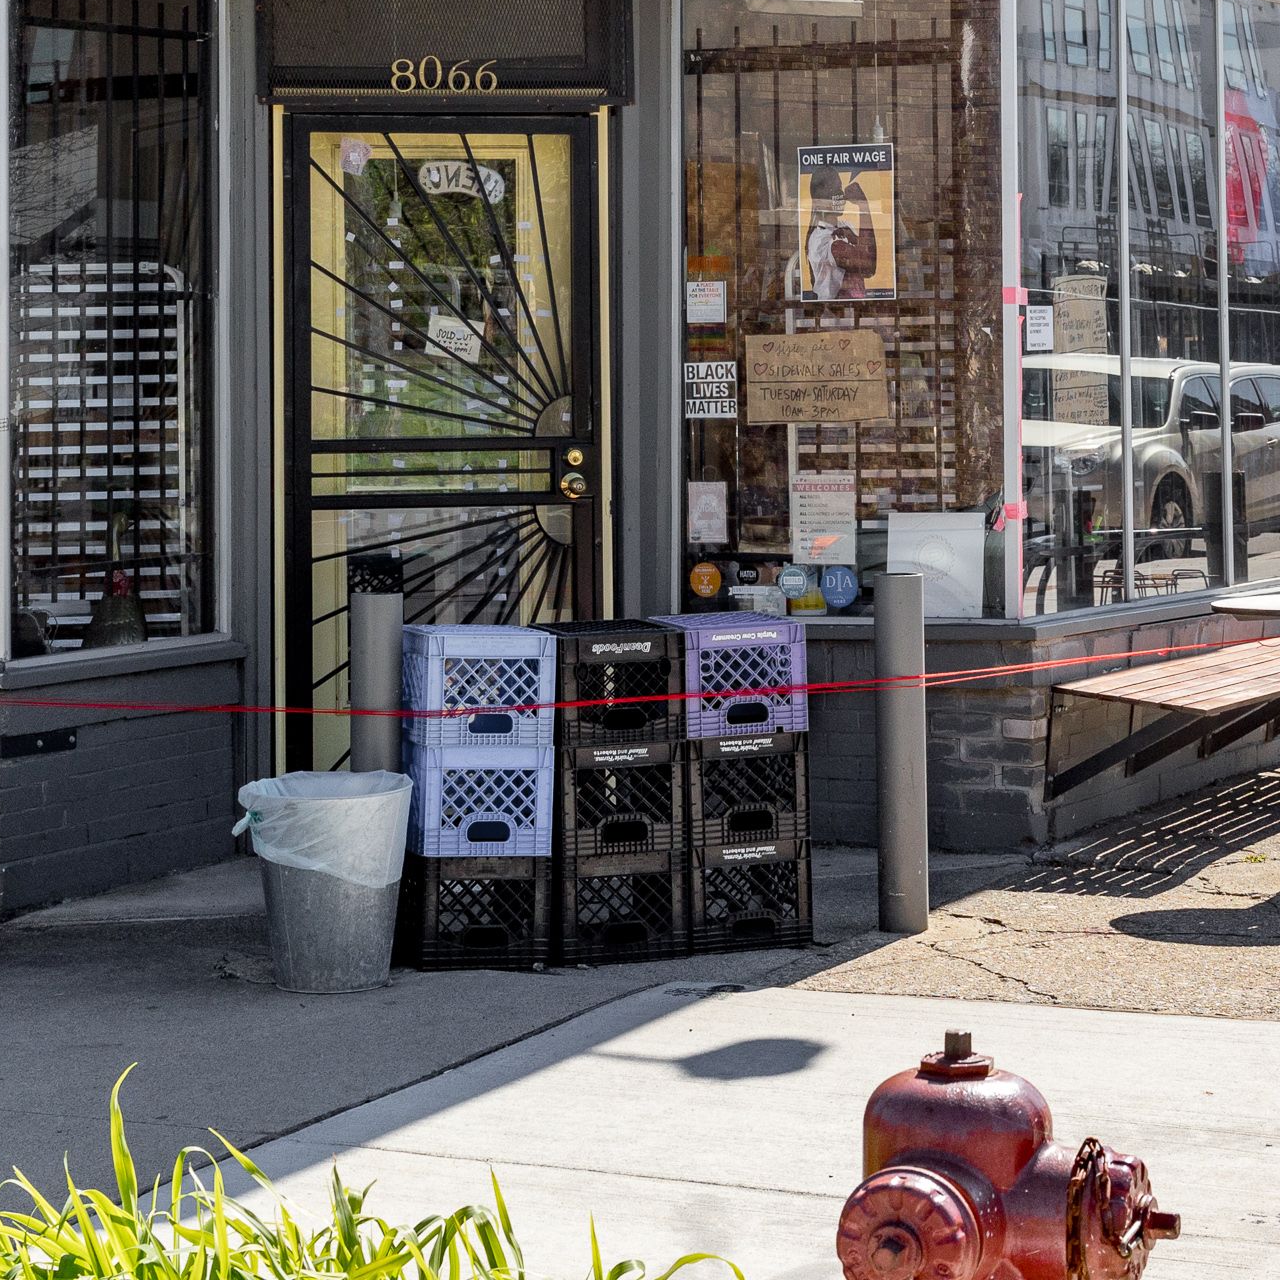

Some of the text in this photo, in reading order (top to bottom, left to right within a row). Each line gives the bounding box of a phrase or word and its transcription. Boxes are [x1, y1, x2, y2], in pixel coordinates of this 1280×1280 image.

[391, 55, 498, 93] 8066
[802, 151, 886, 165] ONE FAIR WAGE
[436, 328, 456, 340] SOLD
[686, 364, 735, 380] BLACK
[829, 362, 861, 377] SALES
[693, 383, 729, 397] LIVES
[686, 400, 736, 414] MATTER
[740, 570, 757, 578] HATCH
[757, 631, 777, 639] Purple
